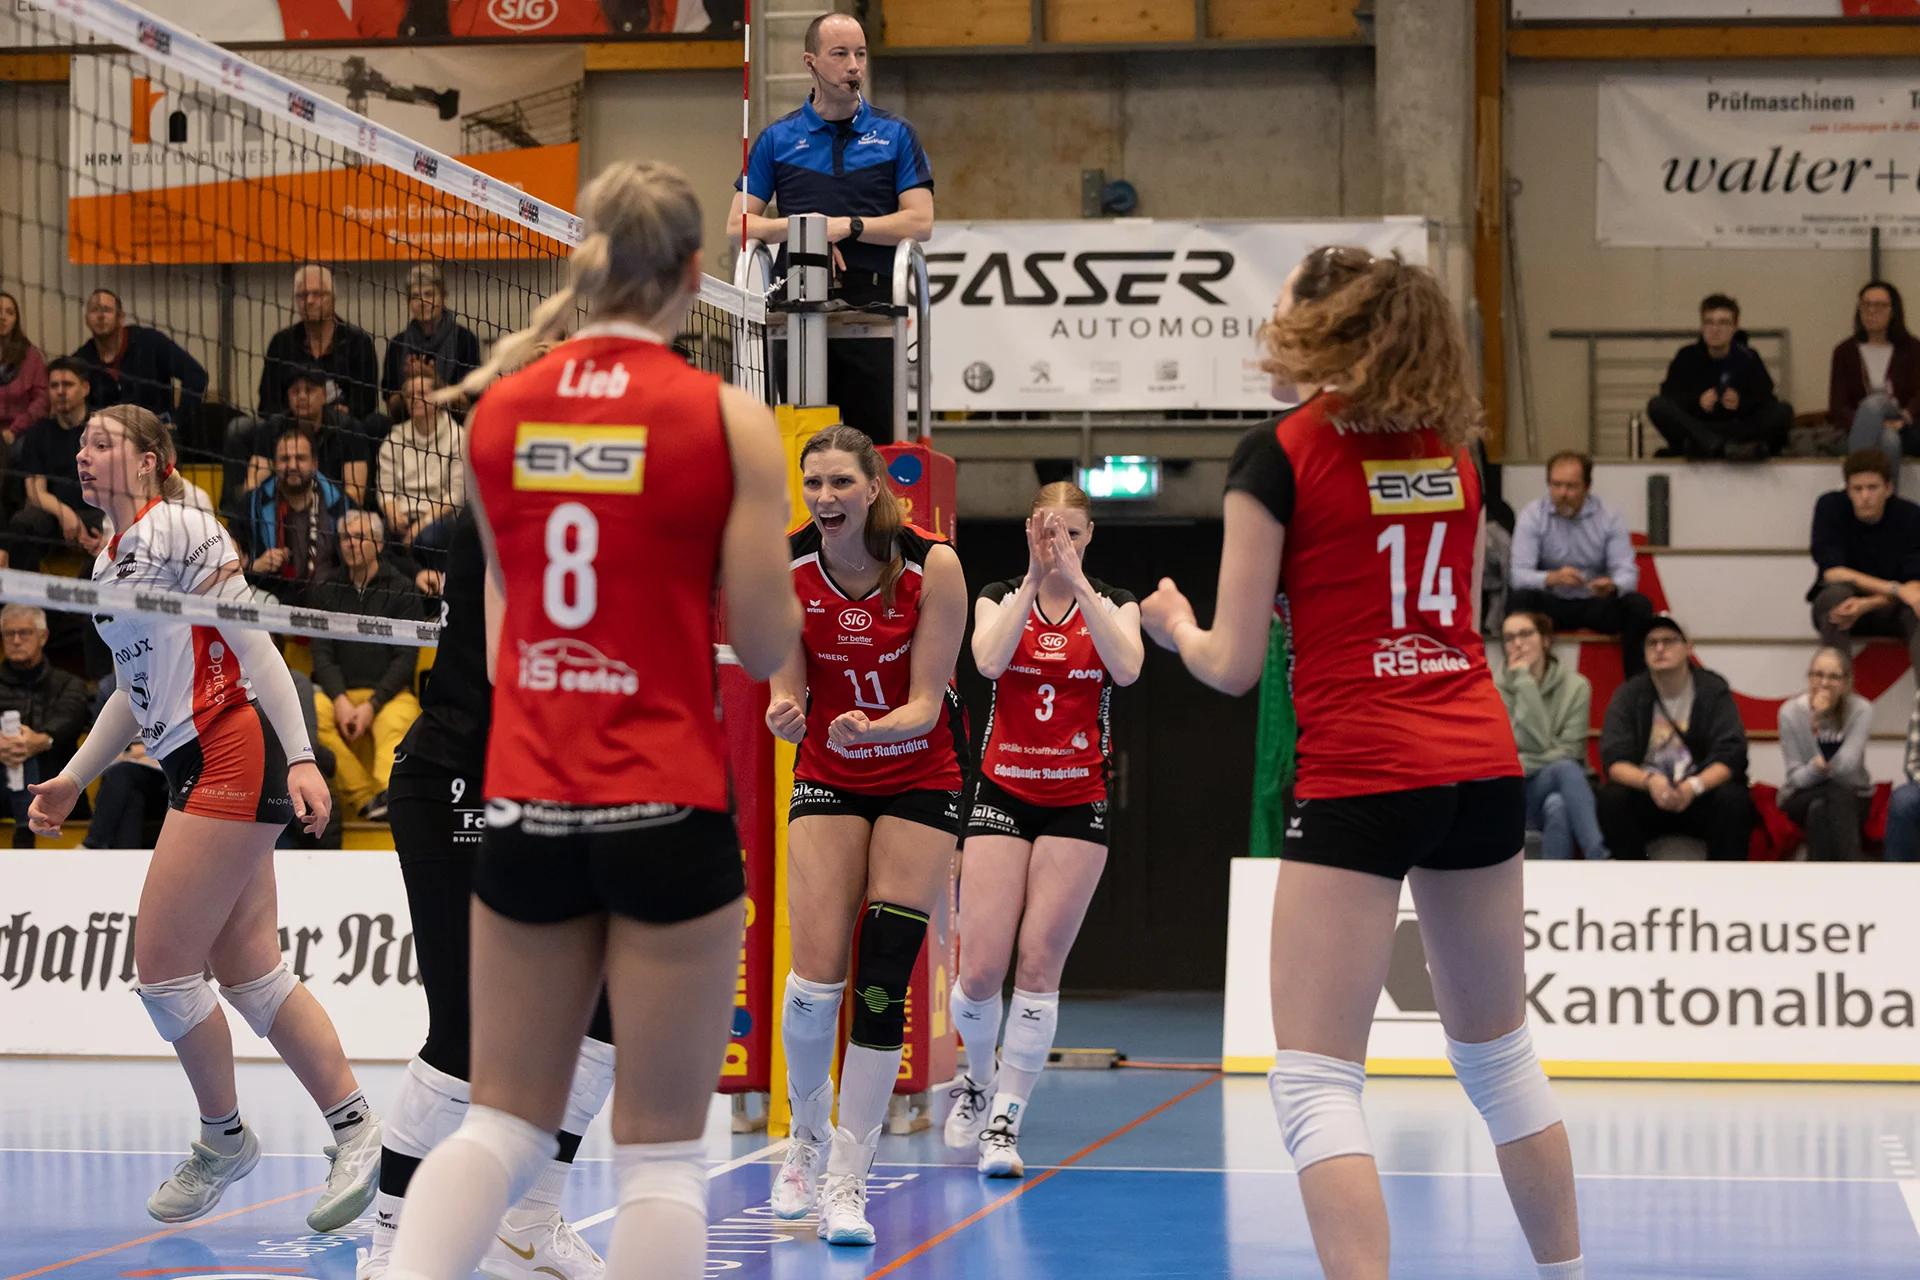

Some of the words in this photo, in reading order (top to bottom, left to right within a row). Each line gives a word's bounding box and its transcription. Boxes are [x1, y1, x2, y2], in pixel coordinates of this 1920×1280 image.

[499, 0, 545, 19] SIG
[1706, 91, 1855, 112] Prüfmaschinen
[85, 153, 122, 167] HRM
[131, 151, 165, 166] BAU
[1661, 145, 1920, 195] walter+
[909, 249, 1235, 306] GASSER
[556, 359, 631, 399] Lieb
[519, 442, 645, 475] EKS
[1370, 472, 1458, 499] EKS
[184, 534, 223, 567] RAIFFEISEN
[544, 502, 599, 630] 8
[1377, 521, 1457, 630] 14
[843, 612, 867, 626] SIG
[850, 634, 873, 644] better
[1042, 635, 1063, 647] SIG
[1068, 669, 1103, 683] sasag
[1373, 651, 1419, 678] RS
[844, 668, 890, 710] 11
[1035, 683, 1056, 722] 3
[873, 739, 929, 759] Nachrichten
[451, 778, 466, 803] 9
[1524, 908, 1875, 953] Schaffhauser
[1525, 972, 1914, 1027] Kantonalba
[376, 1218, 399, 1230] rima
